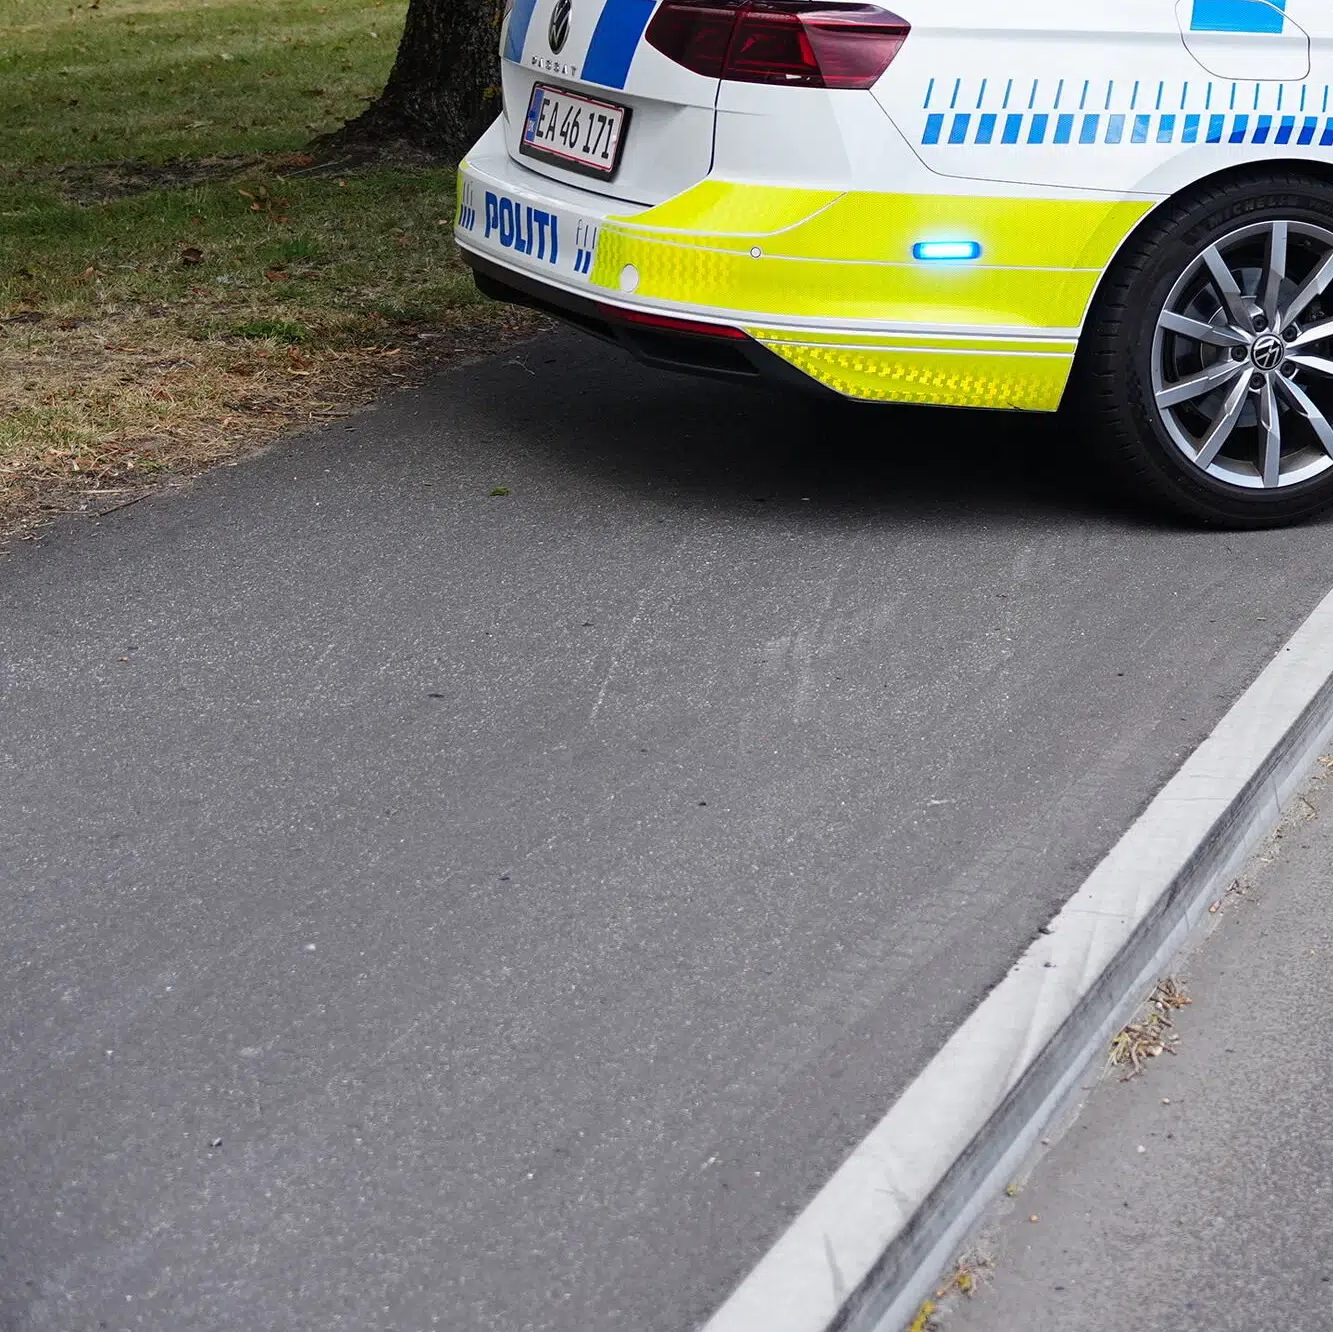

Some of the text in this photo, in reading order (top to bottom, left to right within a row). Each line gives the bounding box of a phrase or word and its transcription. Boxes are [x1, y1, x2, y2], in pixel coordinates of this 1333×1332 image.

[535, 98, 615, 160] EA 46 171
[484, 190, 558, 265] POLITI
